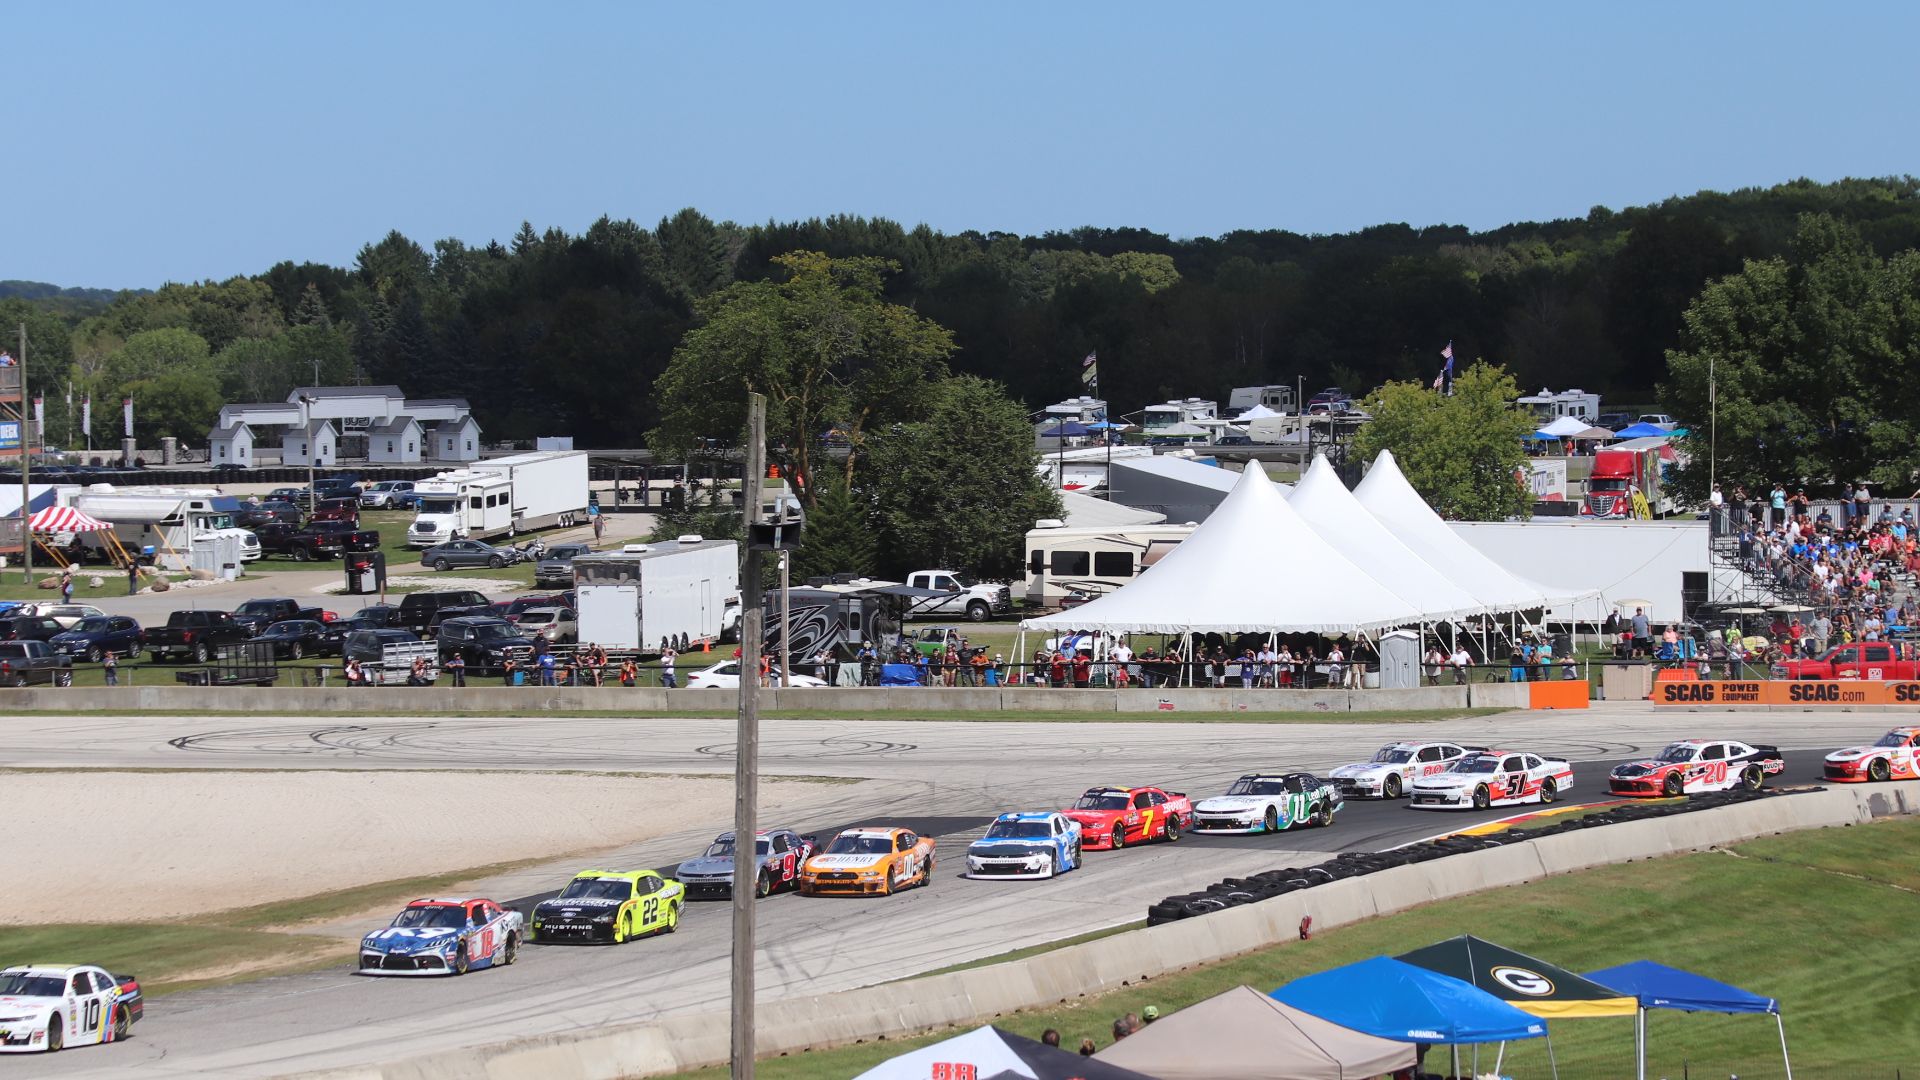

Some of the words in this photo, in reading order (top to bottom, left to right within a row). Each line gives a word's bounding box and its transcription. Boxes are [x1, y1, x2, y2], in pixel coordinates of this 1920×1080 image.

[1665, 684, 1714, 701] SCAG
[1722, 684, 1759, 692] POWER
[1722, 693, 1758, 701] EQUIPMENT
[1790, 684, 1864, 702] SCAG.com
[1505, 773, 1528, 797] 51
[1703, 761, 1727, 785] 20
[1163, 797, 1189, 814] BRANDT
[1294, 795, 1305, 820] 11
[1142, 810, 1154, 836] 7
[783, 853, 795, 881] 9
[642, 897, 659, 926] 22
[481, 929, 494, 959] 18
[82, 998, 100, 1033] 10
